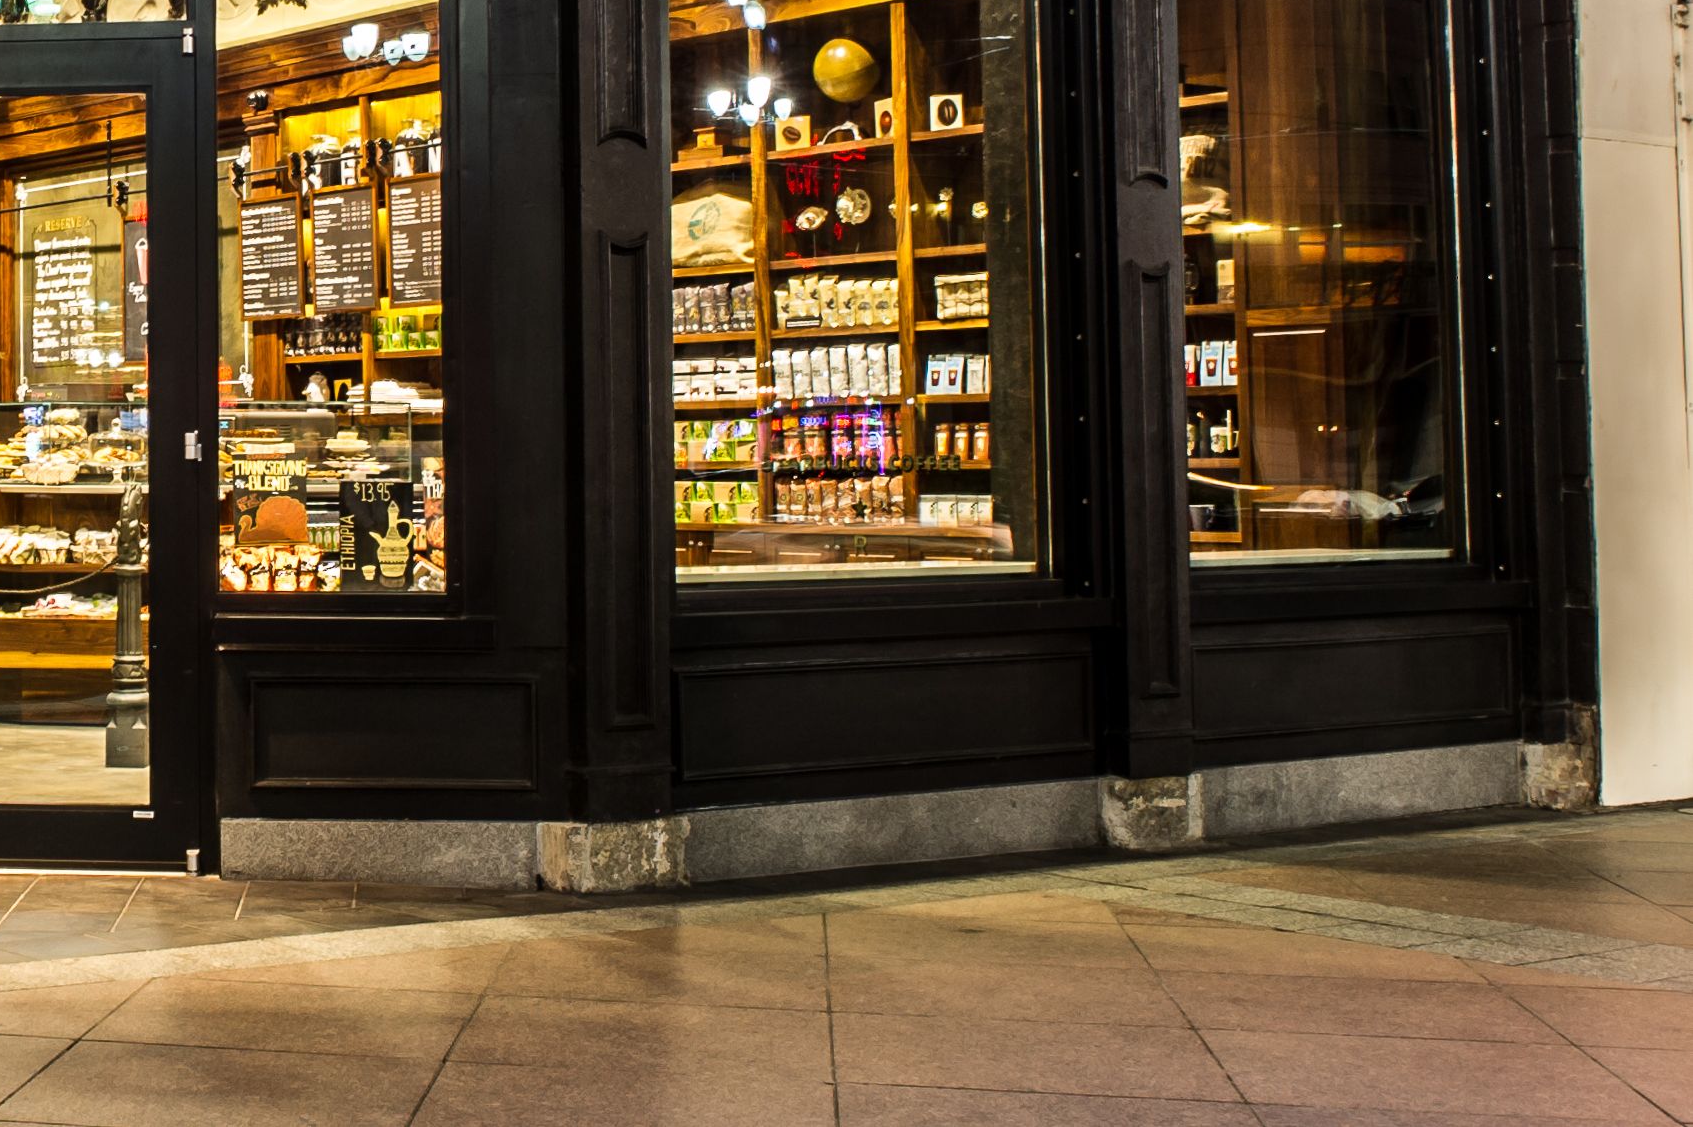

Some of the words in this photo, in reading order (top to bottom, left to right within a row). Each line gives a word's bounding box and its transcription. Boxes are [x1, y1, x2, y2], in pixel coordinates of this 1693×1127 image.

[45, 216, 82, 232] RESERVE
[232, 459, 307, 477] THANKSGIVING
[888, 454, 961, 471] COFFEE
[248, 475, 291, 492] BLEND
[353, 482, 395, 503] $13.95
[340, 514, 356, 571] ETHIOPIA
